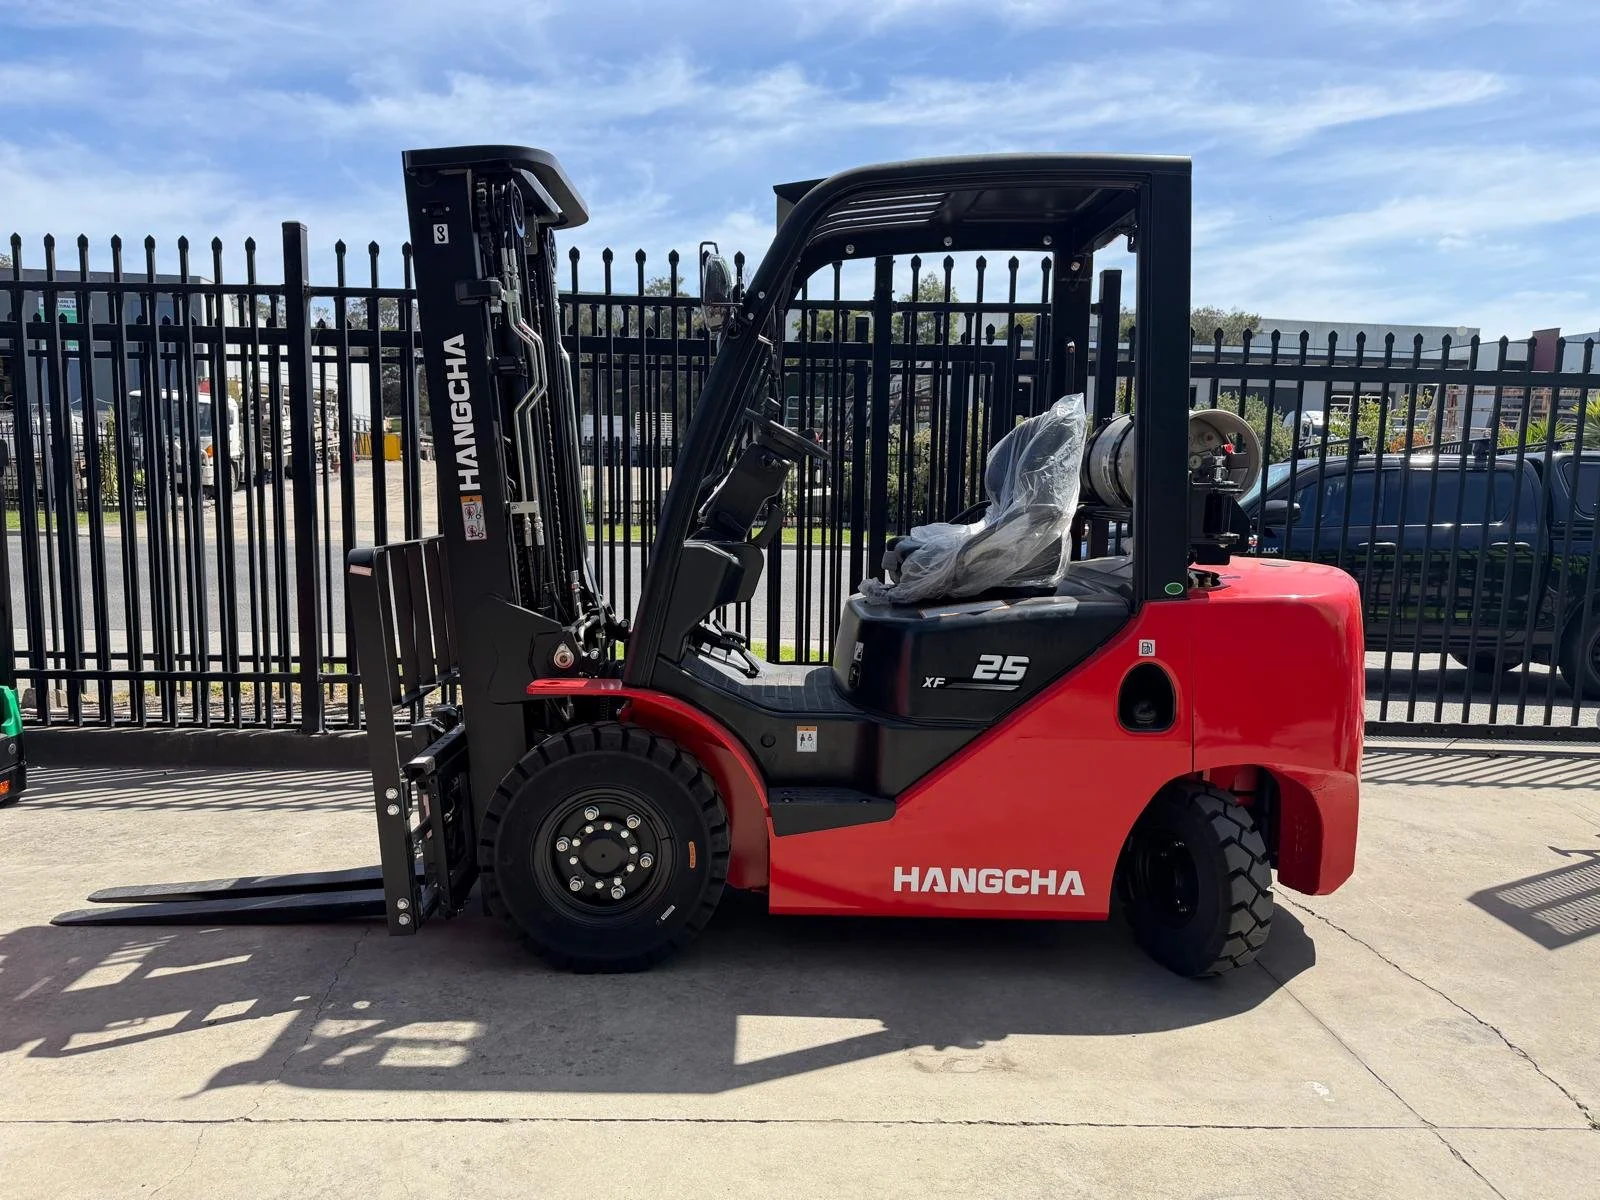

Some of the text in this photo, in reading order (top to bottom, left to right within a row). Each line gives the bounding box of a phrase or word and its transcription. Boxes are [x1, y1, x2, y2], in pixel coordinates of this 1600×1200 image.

[443, 333, 481, 491] HANGCHA
[922, 654, 1030, 688] XF 25
[893, 866, 1086, 896] HANGCHA
